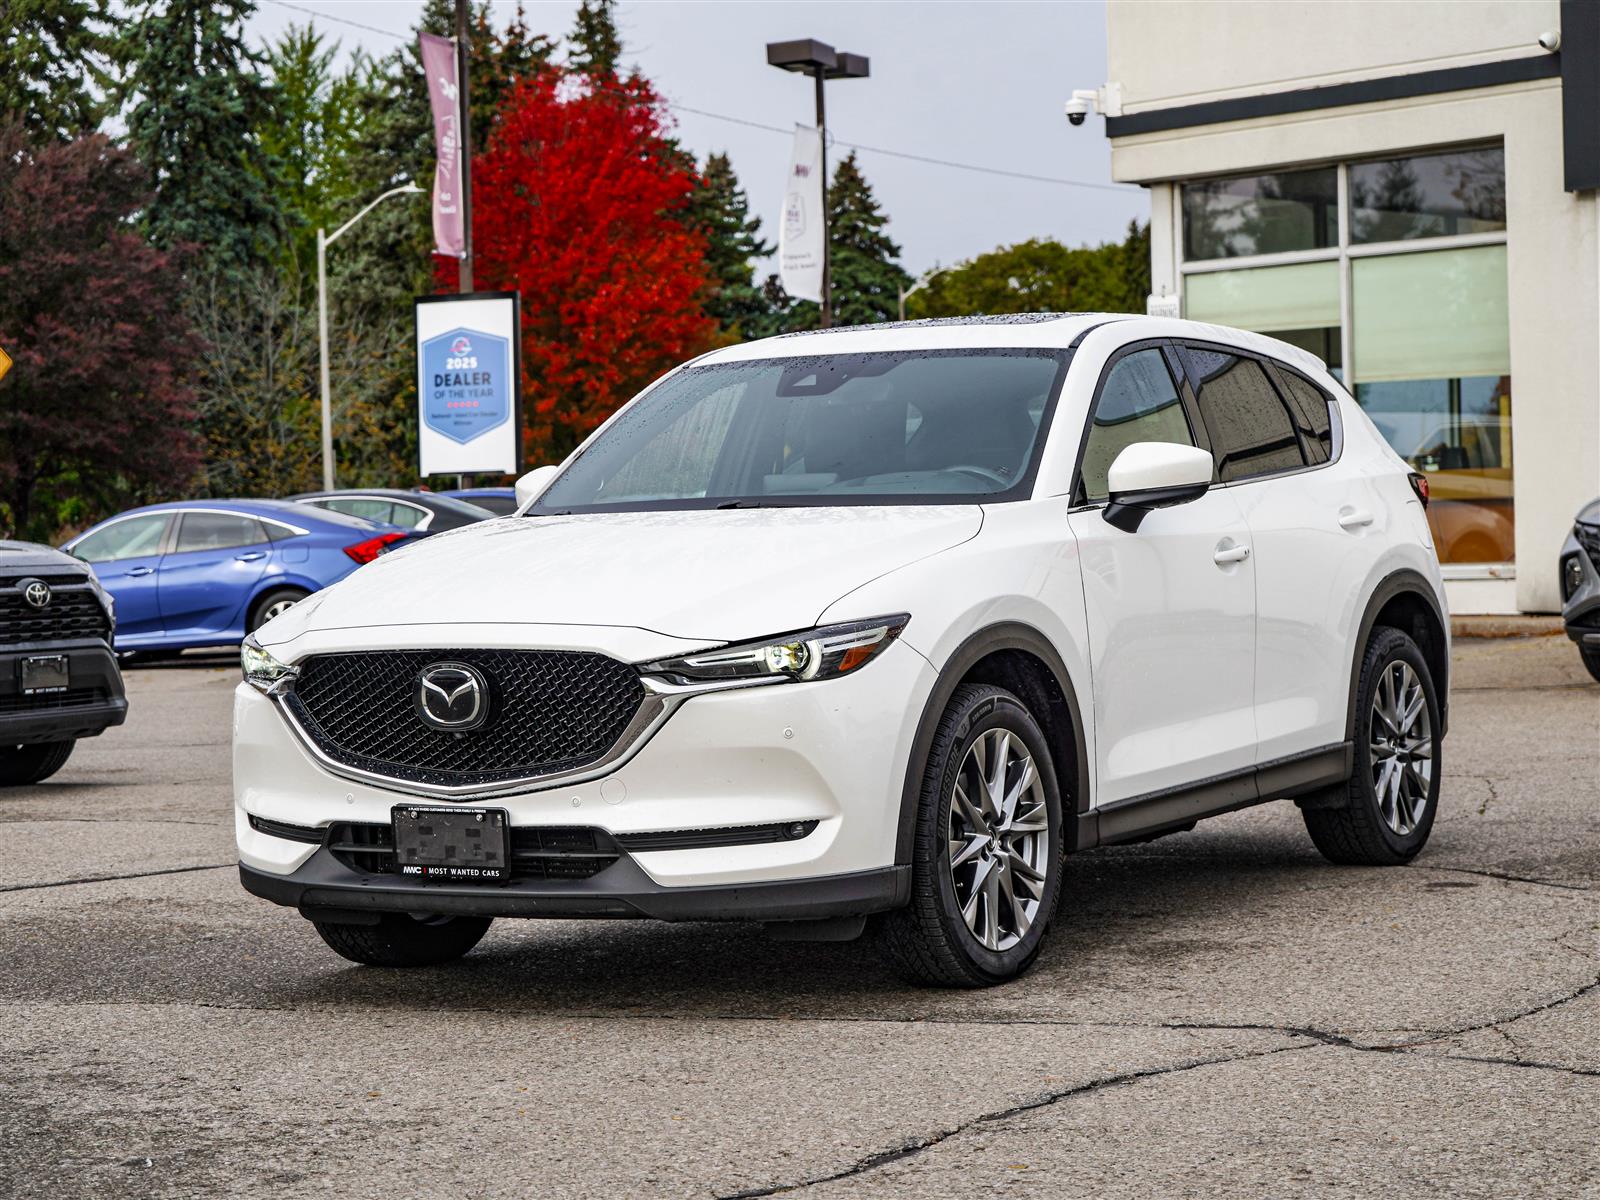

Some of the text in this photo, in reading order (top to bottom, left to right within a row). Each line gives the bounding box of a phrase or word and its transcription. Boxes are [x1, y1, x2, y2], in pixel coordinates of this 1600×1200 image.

[446, 357, 478, 369] 2025
[434, 372, 491, 387] DEALER
[434, 388, 494, 400] OF THE YEAR
[937, 745, 960, 840] BRIDGESTONE
[428, 867, 447, 875] MOST
[450, 868, 479, 876] WANTED
[482, 869, 500, 877] CARS
